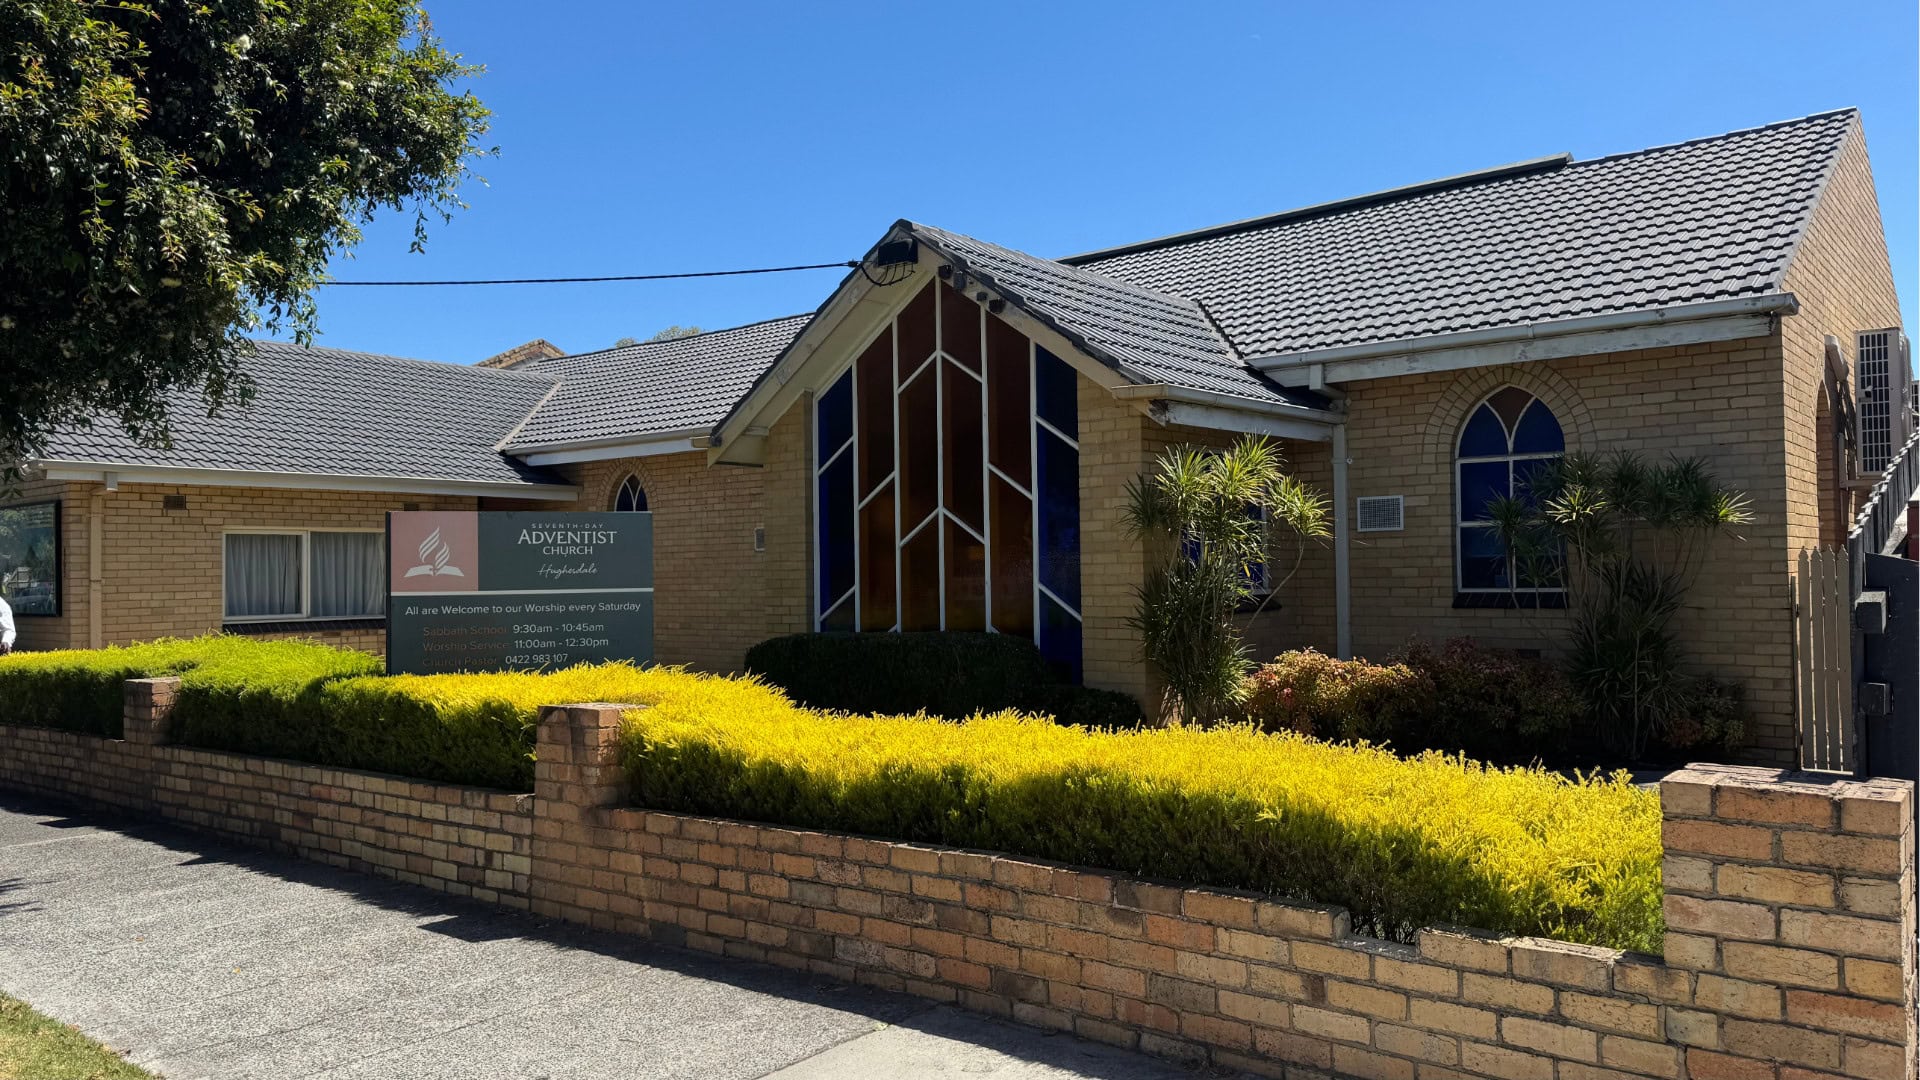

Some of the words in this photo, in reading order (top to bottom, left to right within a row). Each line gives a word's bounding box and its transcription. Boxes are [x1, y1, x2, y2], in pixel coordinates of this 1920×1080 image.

[517, 528, 618, 545] ADVENTIST
[542, 545, 593, 557] CHURCH
[536, 562, 598, 580] Hughesdale
[405, 606, 419, 616] All
[421, 607, 439, 615] are
[441, 604, 490, 615] Welcome
[492, 605, 503, 614] to
[505, 605, 522, 613] our
[524, 602, 566, 613] Worship
[568, 603, 596, 613] every
[598, 601, 641, 612] Saturday
[512, 624, 553, 634] 9:30am
[561, 622, 605, 632] 10:45am
[514, 639, 556, 649] 11:00am
[565, 637, 609, 648] 12:30pm
[505, 655, 530, 665] 0422
[532, 654, 551, 664] 983
[553, 653, 569, 663] 107
